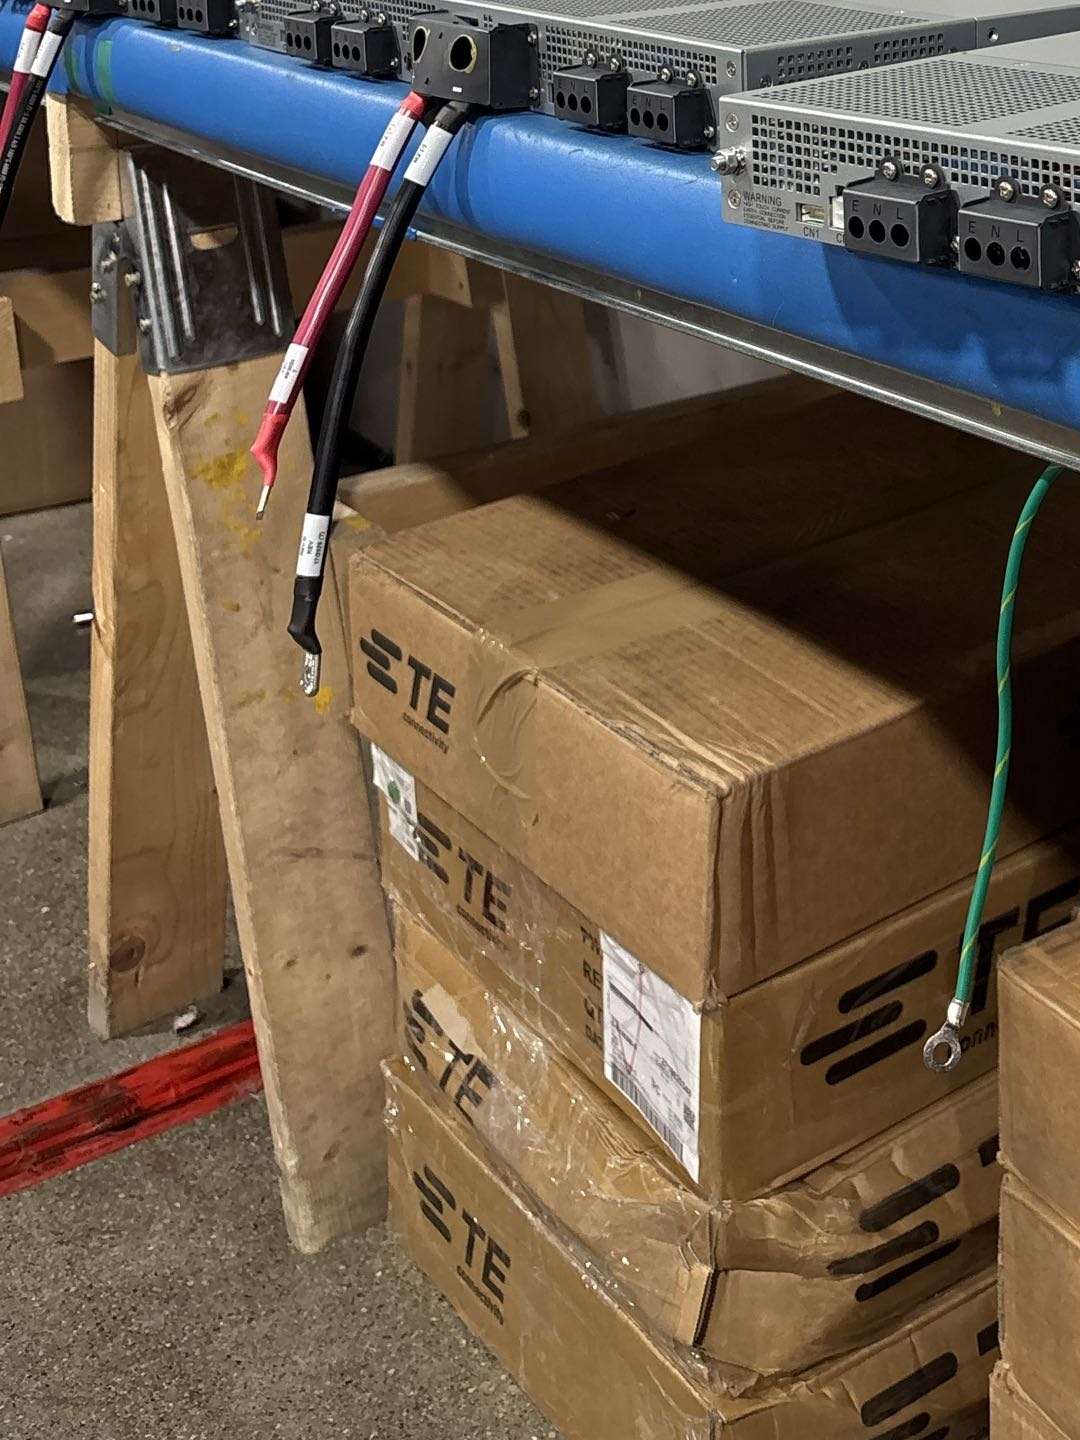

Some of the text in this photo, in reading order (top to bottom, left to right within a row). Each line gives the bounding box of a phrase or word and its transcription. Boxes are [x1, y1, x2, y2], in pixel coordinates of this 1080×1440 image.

[852, 199, 903, 220] E N L
[803, 226, 820, 240] CN1
[968, 220, 1025, 243] E N L
[408, 654, 457, 735] TE
[458, 846, 512, 933] TE
[582, 960, 602, 990] RE
[462, 1207, 511, 1304] TE
